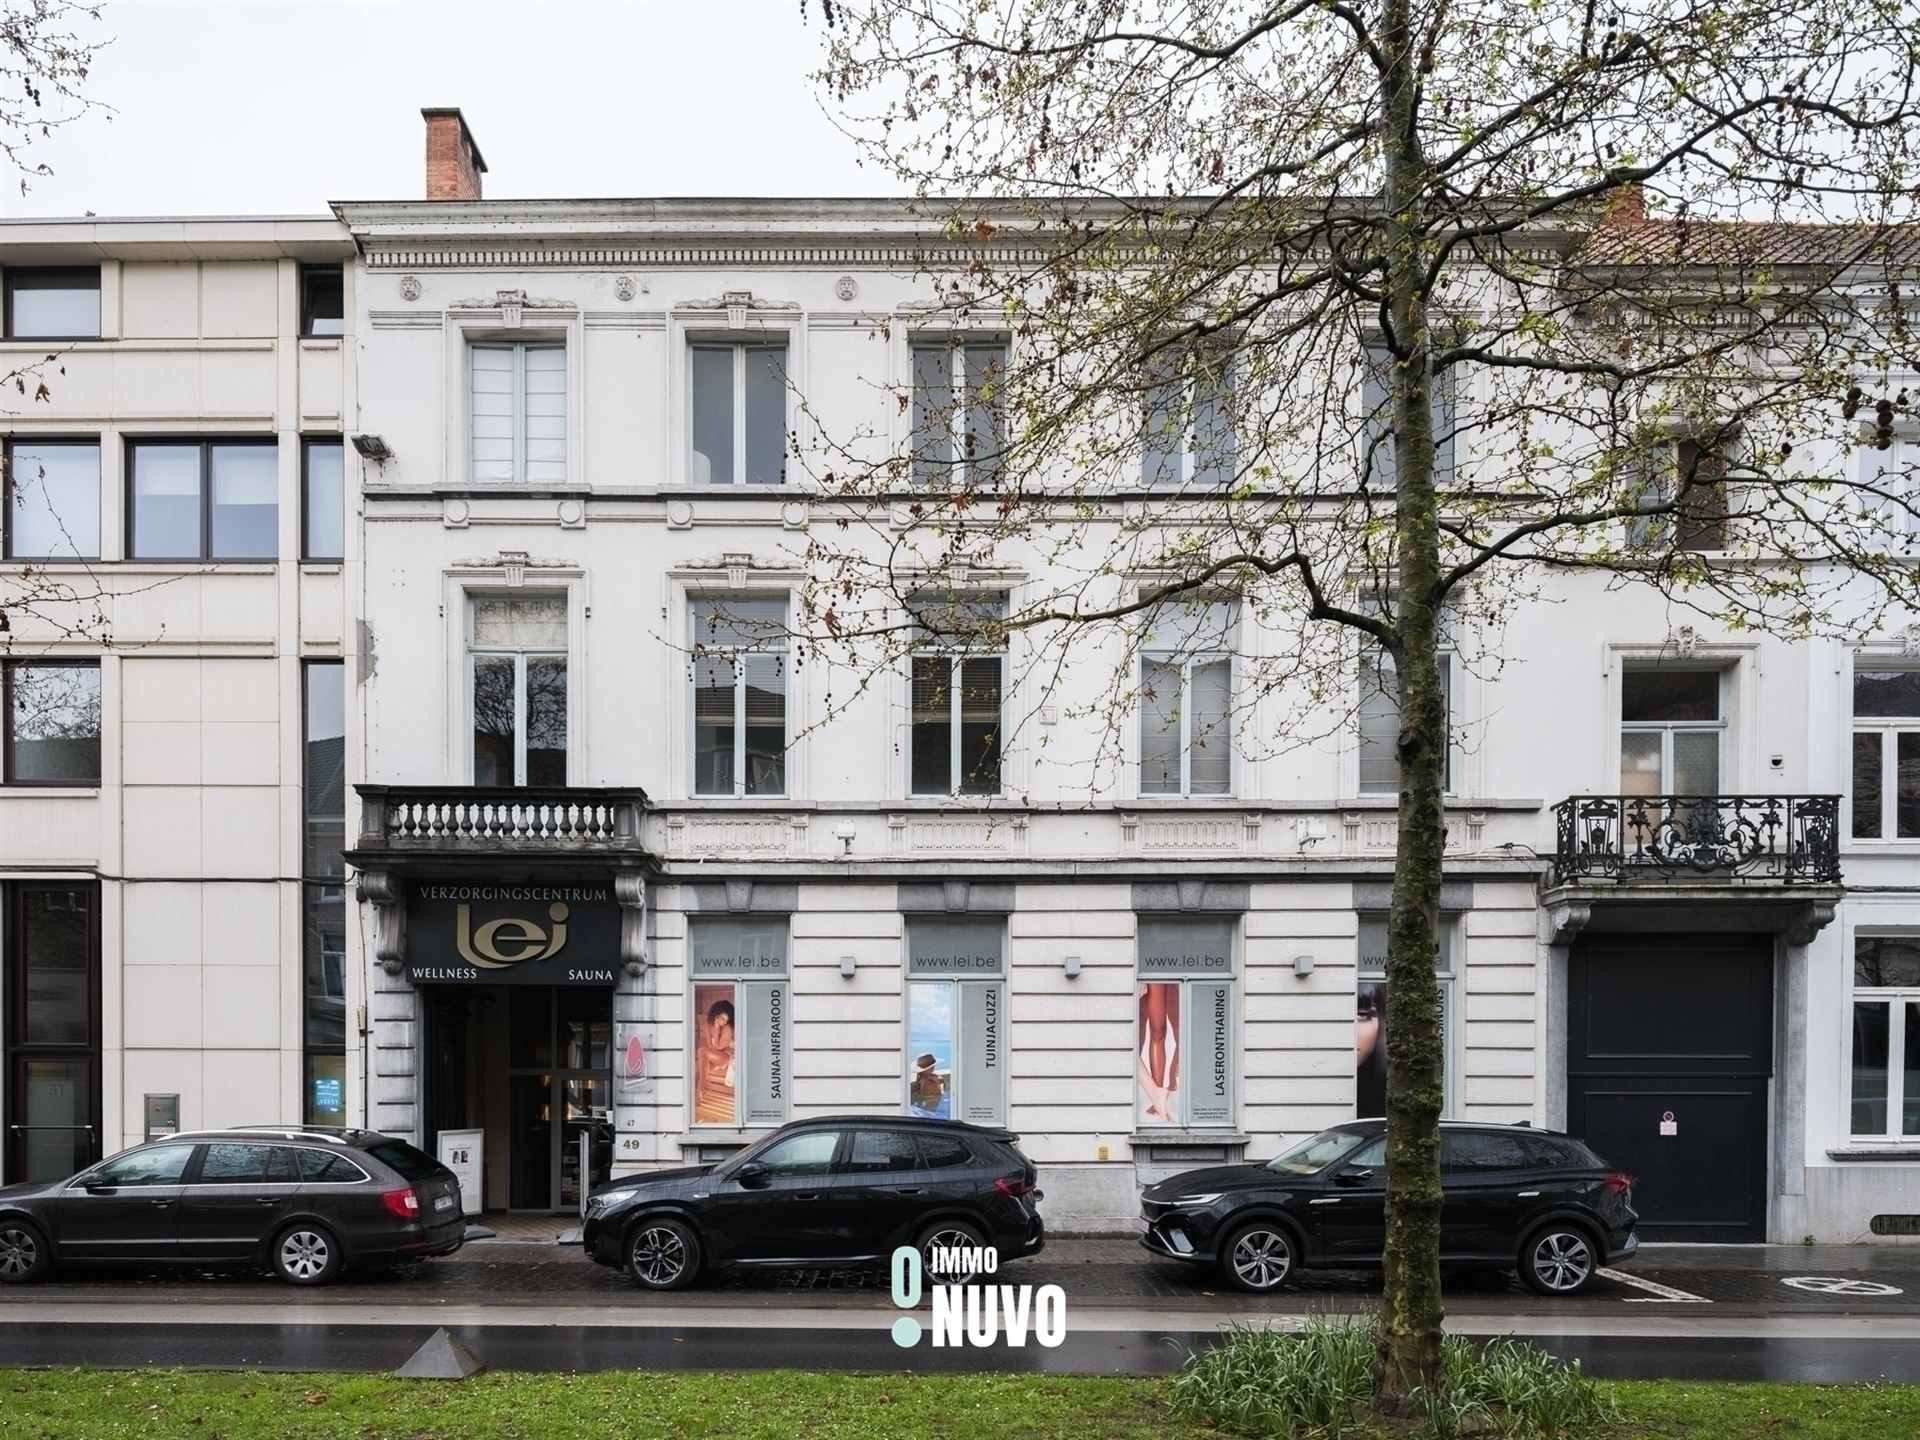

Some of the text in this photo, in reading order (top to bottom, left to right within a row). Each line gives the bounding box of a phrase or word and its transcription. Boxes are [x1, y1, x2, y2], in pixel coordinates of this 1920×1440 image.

[420, 886, 607, 901] VERZORGINGSCENTRUM
[700, 956, 780, 968] www.lei.be
[915, 956, 995, 968] www.lei.be
[1145, 955, 1225, 967] www.lei.be
[412, 968, 477, 979] WELLNESS
[568, 969, 613, 981] SAUNA
[986, 989, 996, 1069] TUINJACUZZI
[770, 989, 781, 1099] SAUNA-INFRAROOD
[1215, 989, 1225, 1096] LASERONTHARING
[623, 1139, 640, 1150] 49
